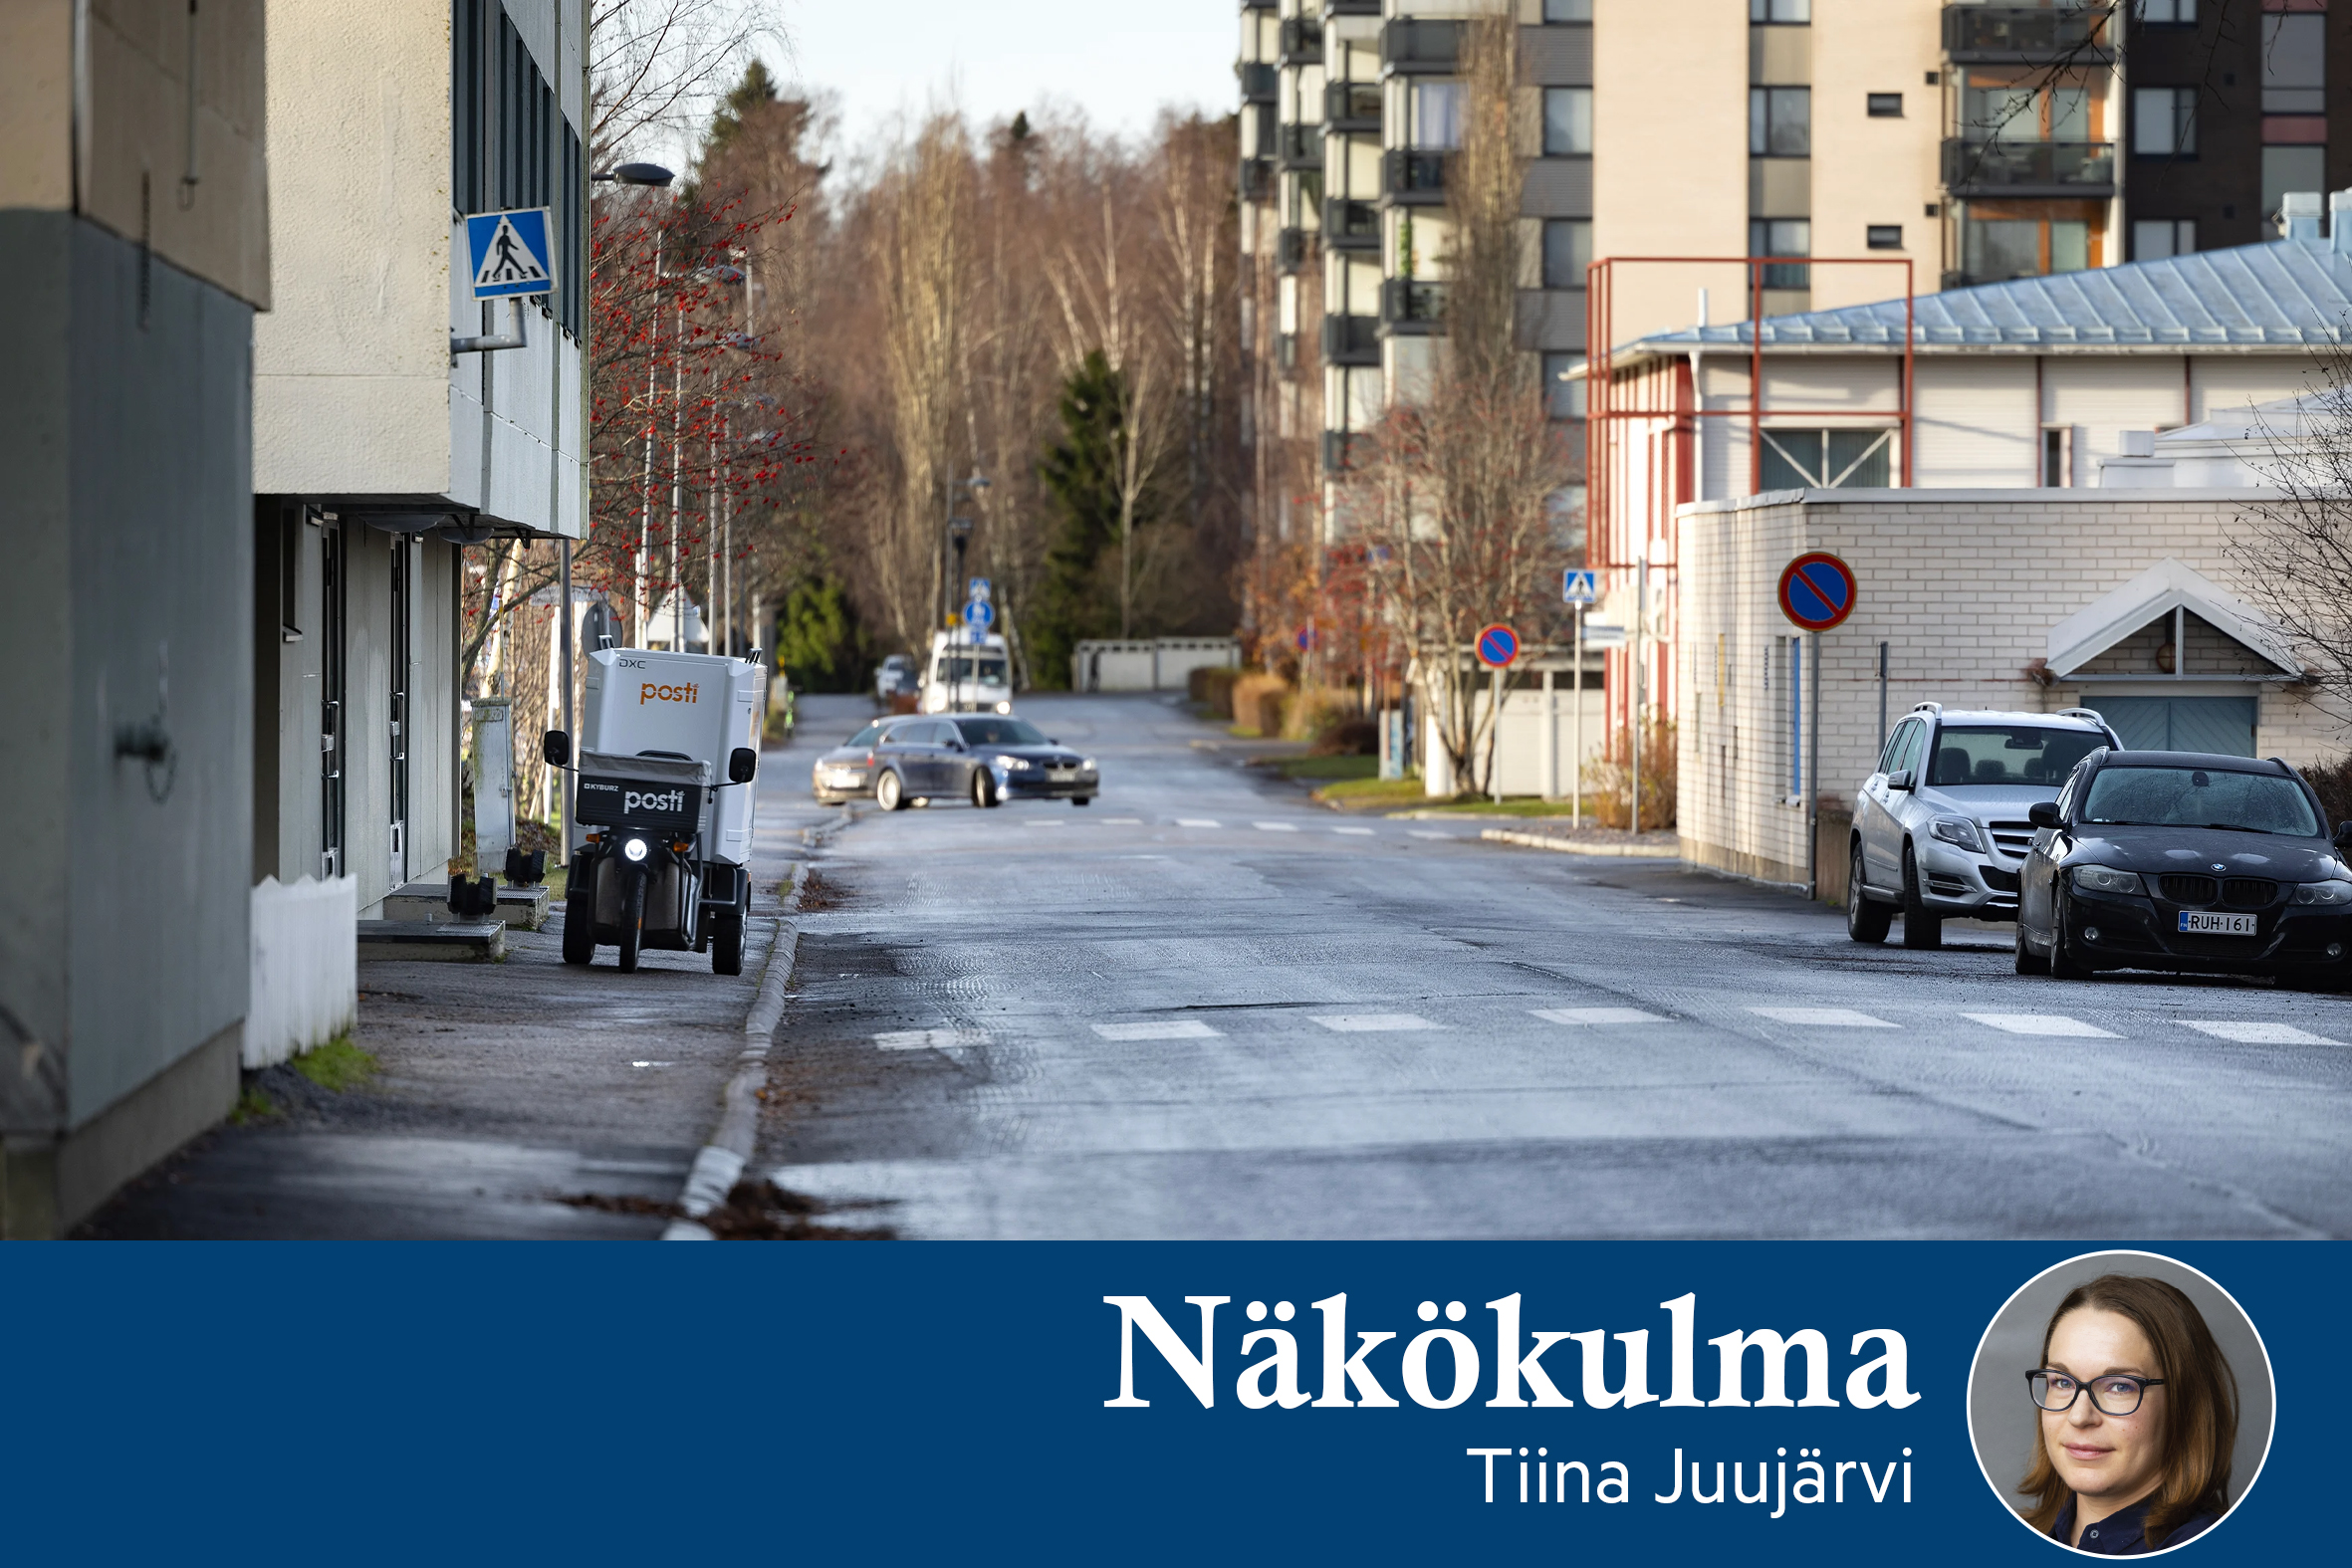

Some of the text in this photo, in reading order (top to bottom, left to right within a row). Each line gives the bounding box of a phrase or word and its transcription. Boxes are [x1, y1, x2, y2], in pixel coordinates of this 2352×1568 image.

[618, 658, 646, 670] DXC
[640, 682, 700, 705] posti
[589, 784, 619, 792] KYBURZ
[623, 789, 685, 814] posti
